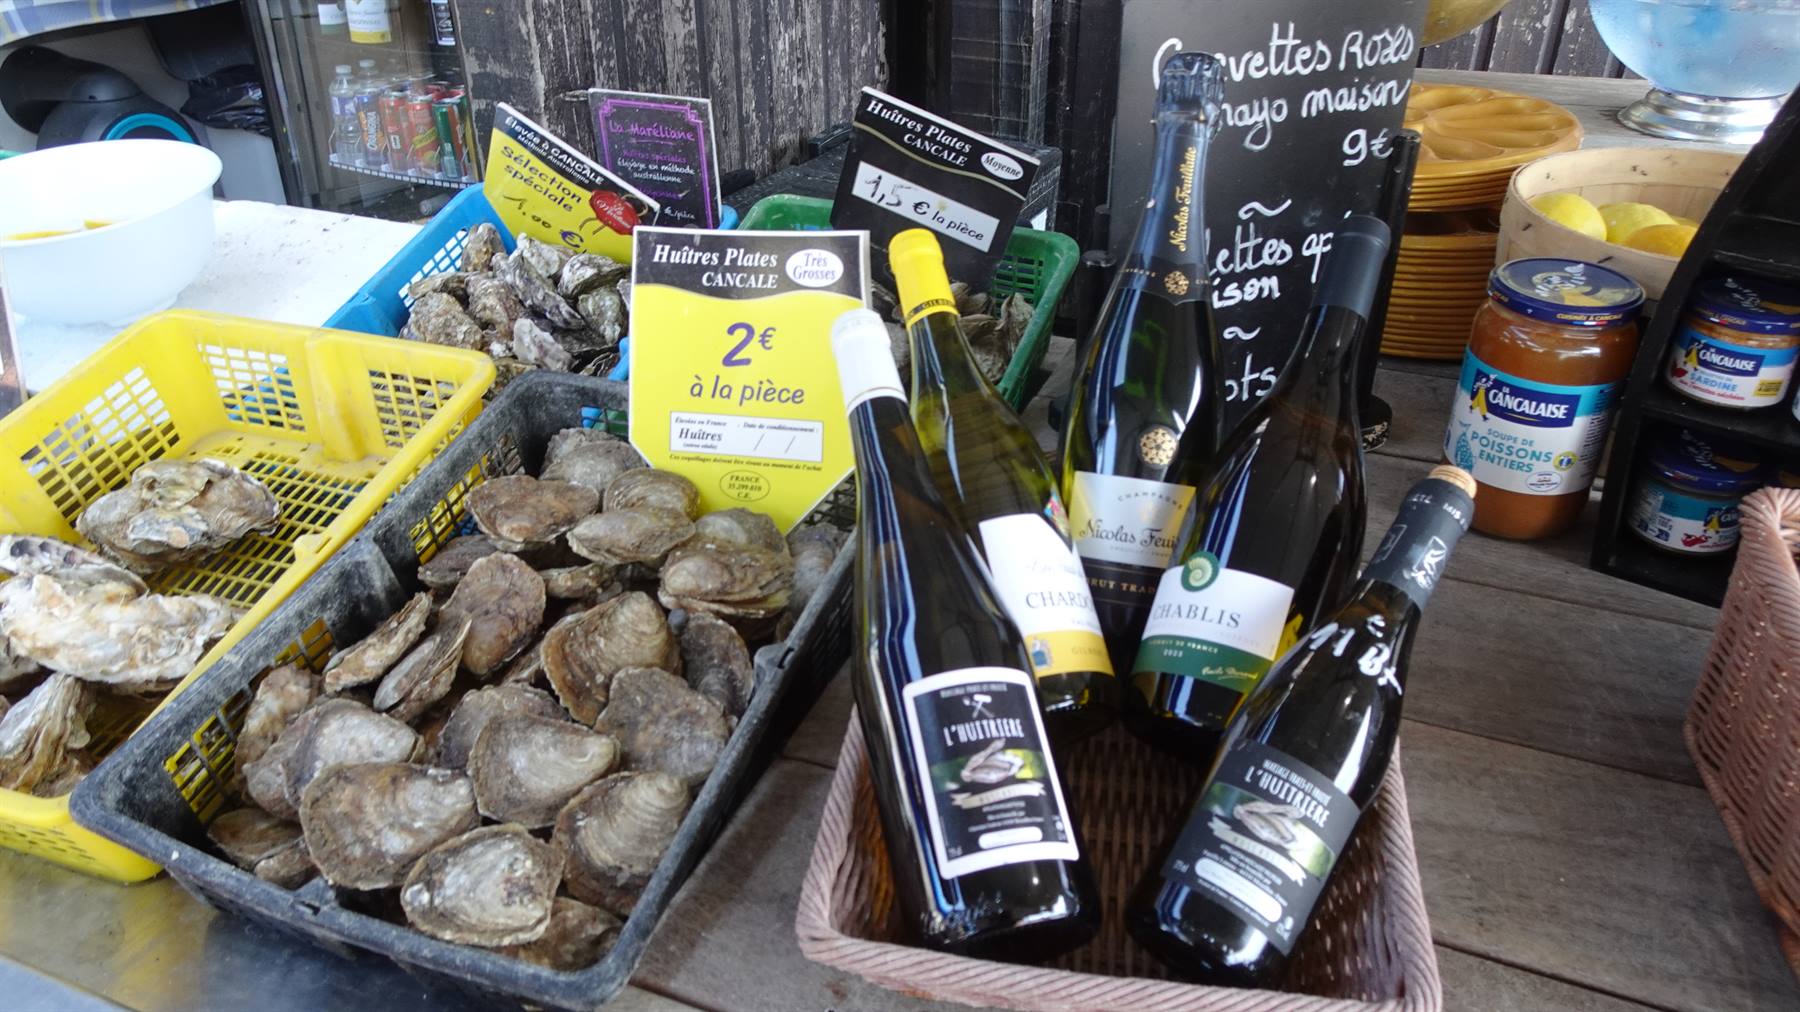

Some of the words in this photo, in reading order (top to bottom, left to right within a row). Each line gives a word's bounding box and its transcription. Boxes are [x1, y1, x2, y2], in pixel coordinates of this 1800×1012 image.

[1153, 21, 1331, 90] Cvettes
[1302, 78, 1411, 118] maison
[866, 100, 923, 133] Huîtres
[926, 125, 972, 153] Plates
[903, 133, 968, 167] CANCALE
[1342, 128, 1394, 166] 9€
[501, 145, 582, 204] Sélection
[550, 147, 605, 185] CANCALE
[984, 155, 1022, 178] Moyenne
[503, 165, 574, 212] spéciale
[912, 201, 930, 216] €
[932, 210, 945, 225] la
[946, 220, 984, 241] pièce
[1169, 205, 1189, 252] Nicolas
[653, 244, 719, 267] Huîtres
[724, 248, 778, 268] Plates
[804, 252, 828, 267] Très
[702, 272, 778, 289] CANCALE
[793, 265, 836, 281] Grosses
[690, 374, 704, 398] à
[711, 375, 733, 400] la
[739, 379, 805, 406] pièce
[1691, 373, 1738, 391] SARDINE
[1488, 389, 1569, 419] CANCALAISE
[679, 428, 722, 441] Huîtres
[1470, 430, 1553, 463] POISSONS
[1488, 428, 1519, 444] SOUPE
[1521, 438, 1535, 447] DE
[1478, 449, 1534, 474] ENTIERS
[730, 474, 760, 484] FRANCE
[1079, 519, 1136, 544] Nicolas
[1152, 604, 1241, 629] CHABLIS
